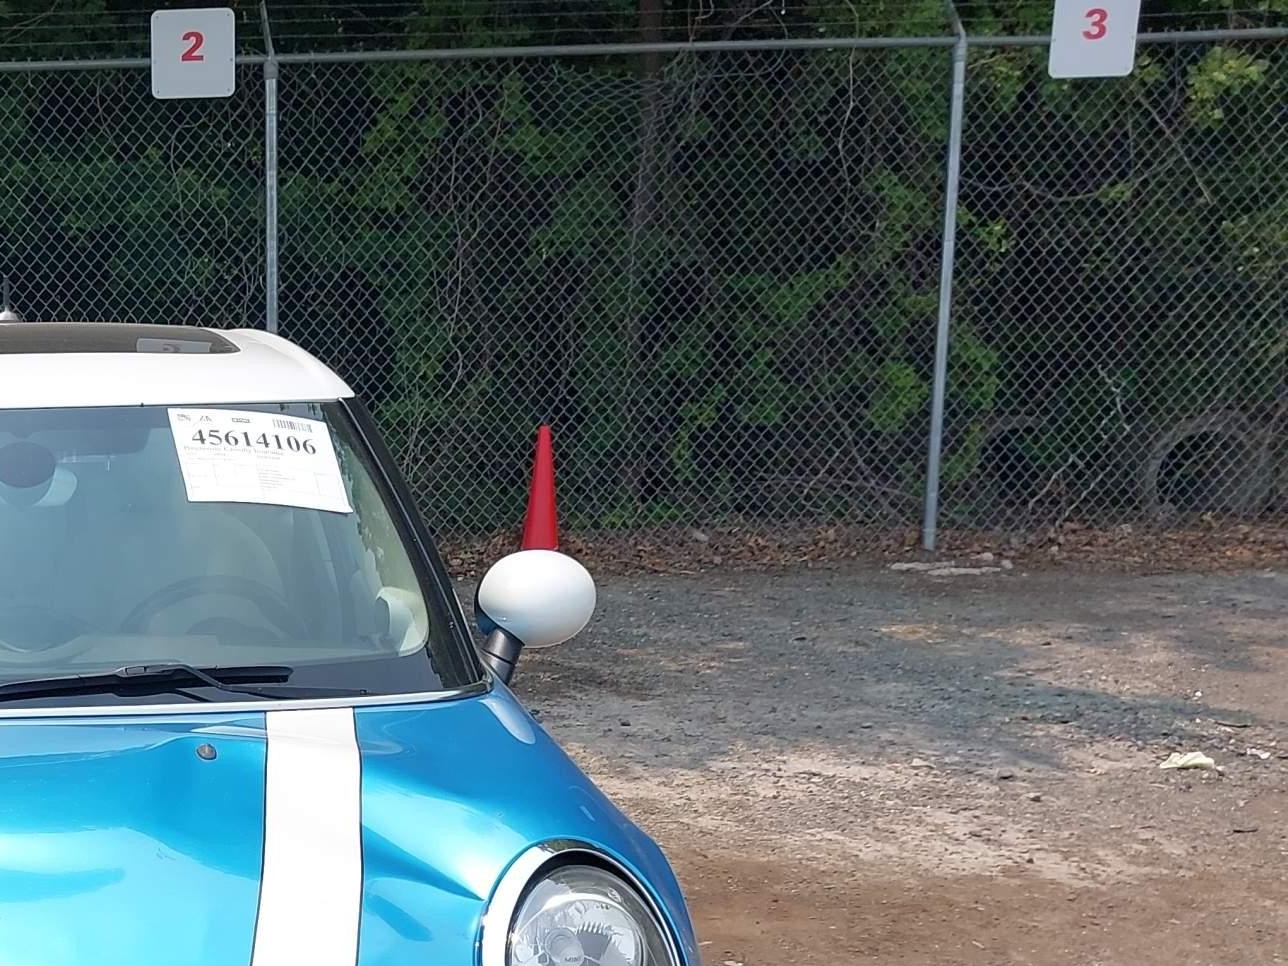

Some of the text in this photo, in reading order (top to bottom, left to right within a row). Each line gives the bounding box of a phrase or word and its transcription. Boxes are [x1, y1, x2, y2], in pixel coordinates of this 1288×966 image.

[1083, 8, 1108, 40] 3
[182, 31, 204, 62] 2
[191, 429, 317, 456] 45614106
